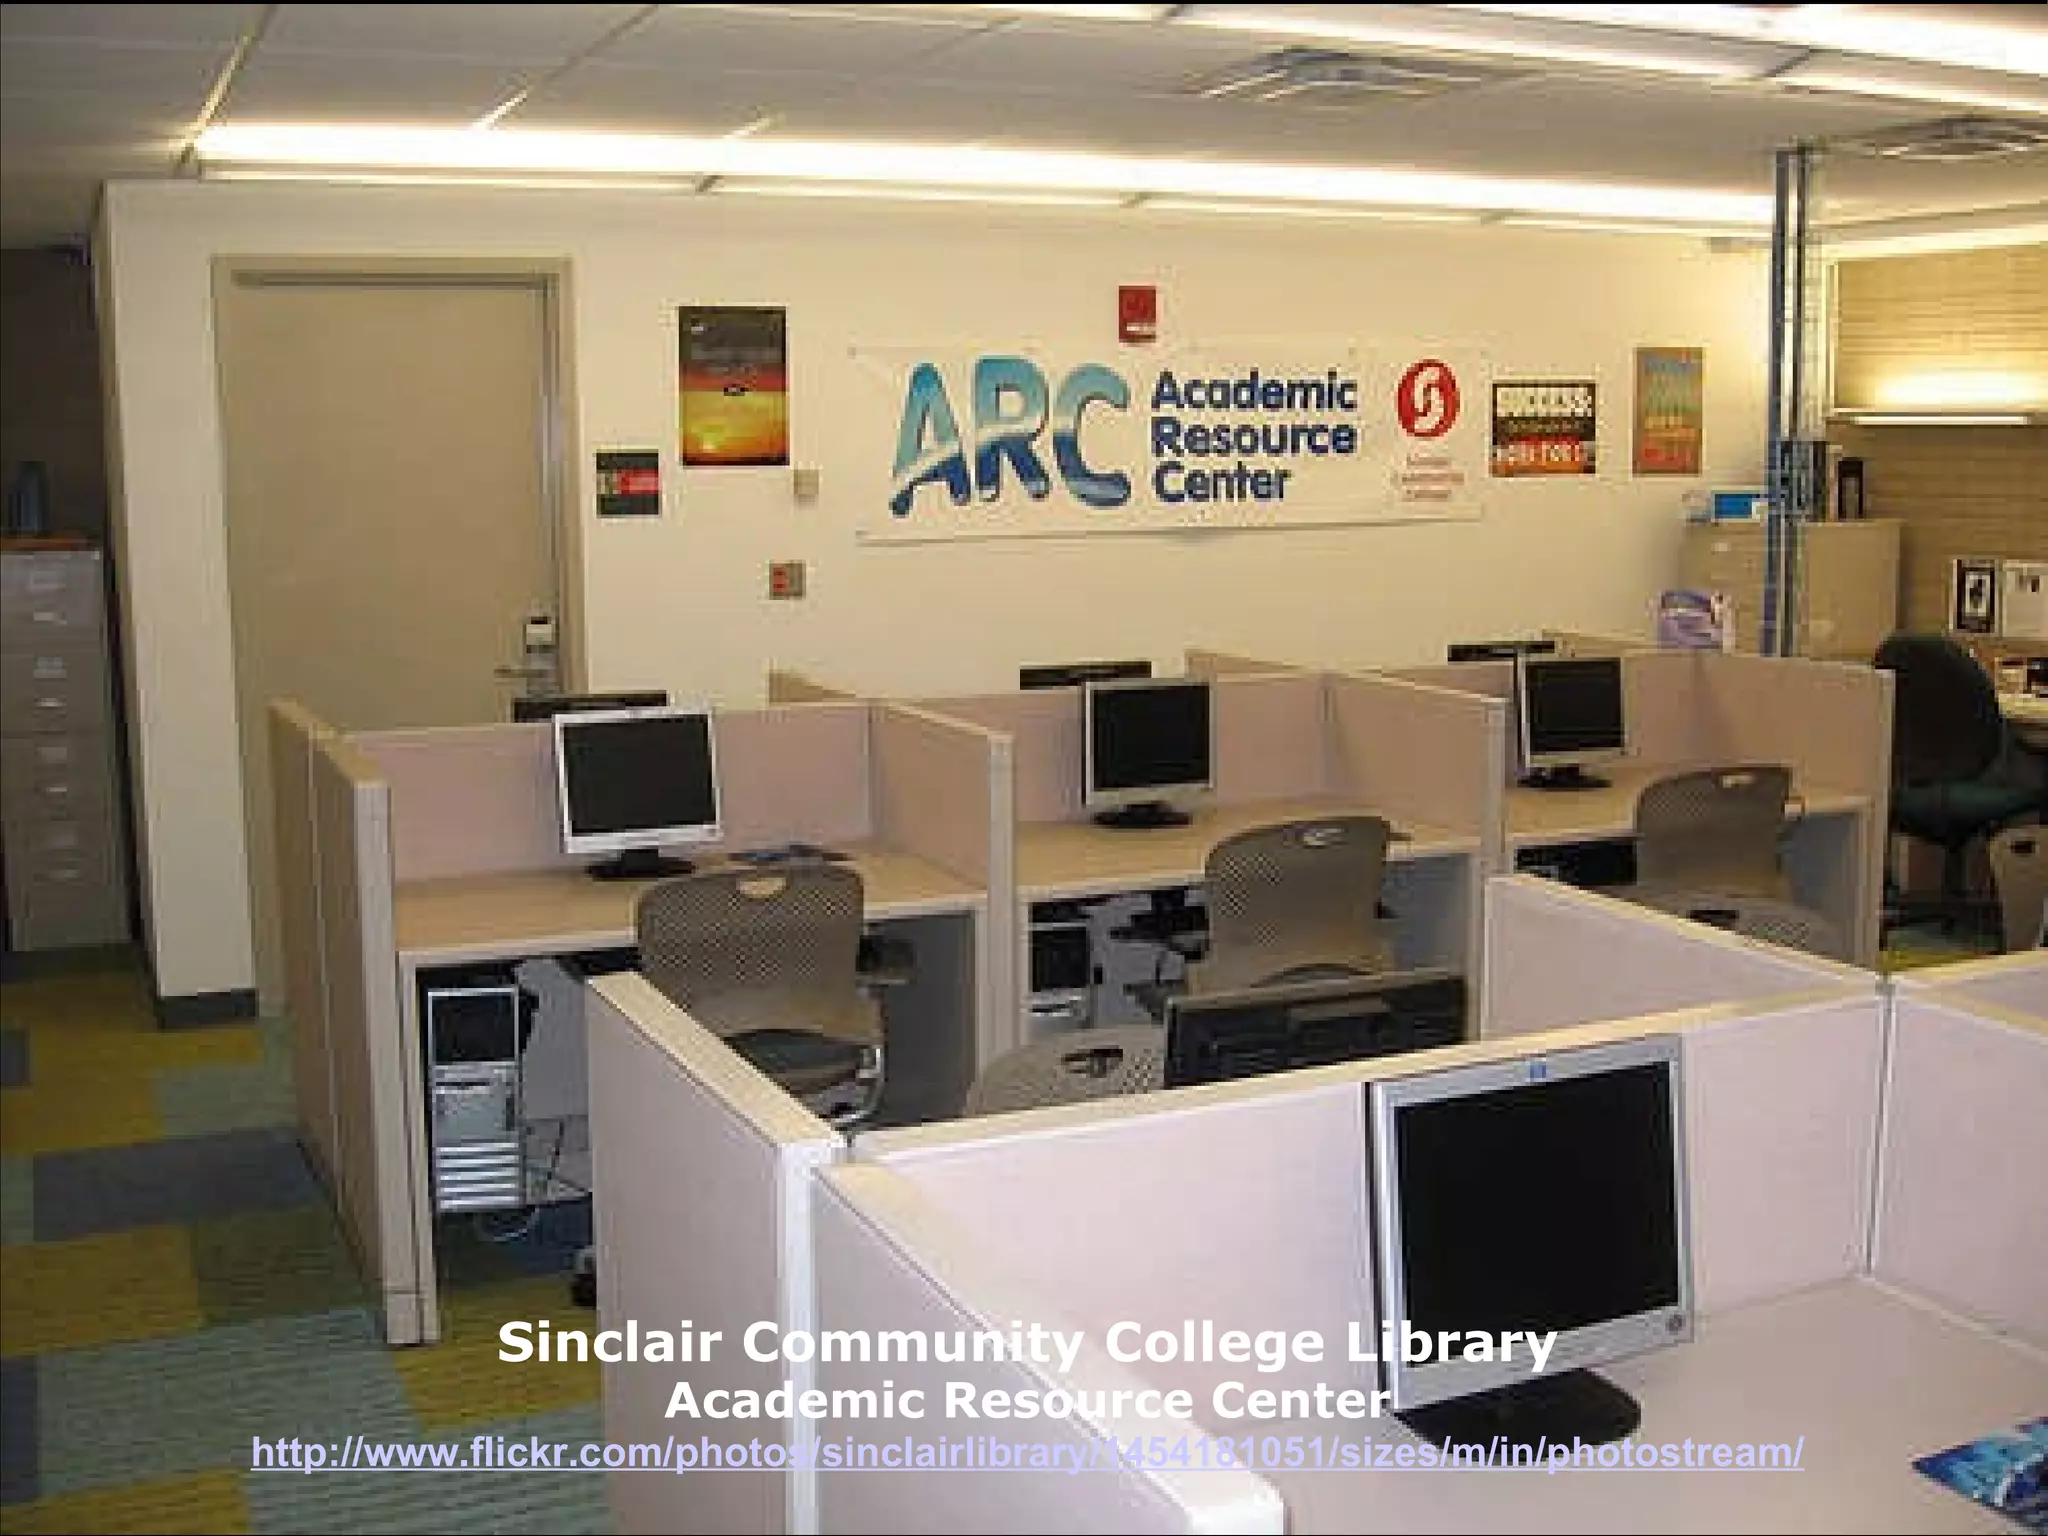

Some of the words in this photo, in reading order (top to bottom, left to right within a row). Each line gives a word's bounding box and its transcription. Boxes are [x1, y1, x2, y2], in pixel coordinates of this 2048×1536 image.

[1151, 369, 1358, 409] Academic
[890, 355, 1131, 517] ARC
[1151, 415, 1358, 457] Resource
[1153, 461, 1292, 503] Center
